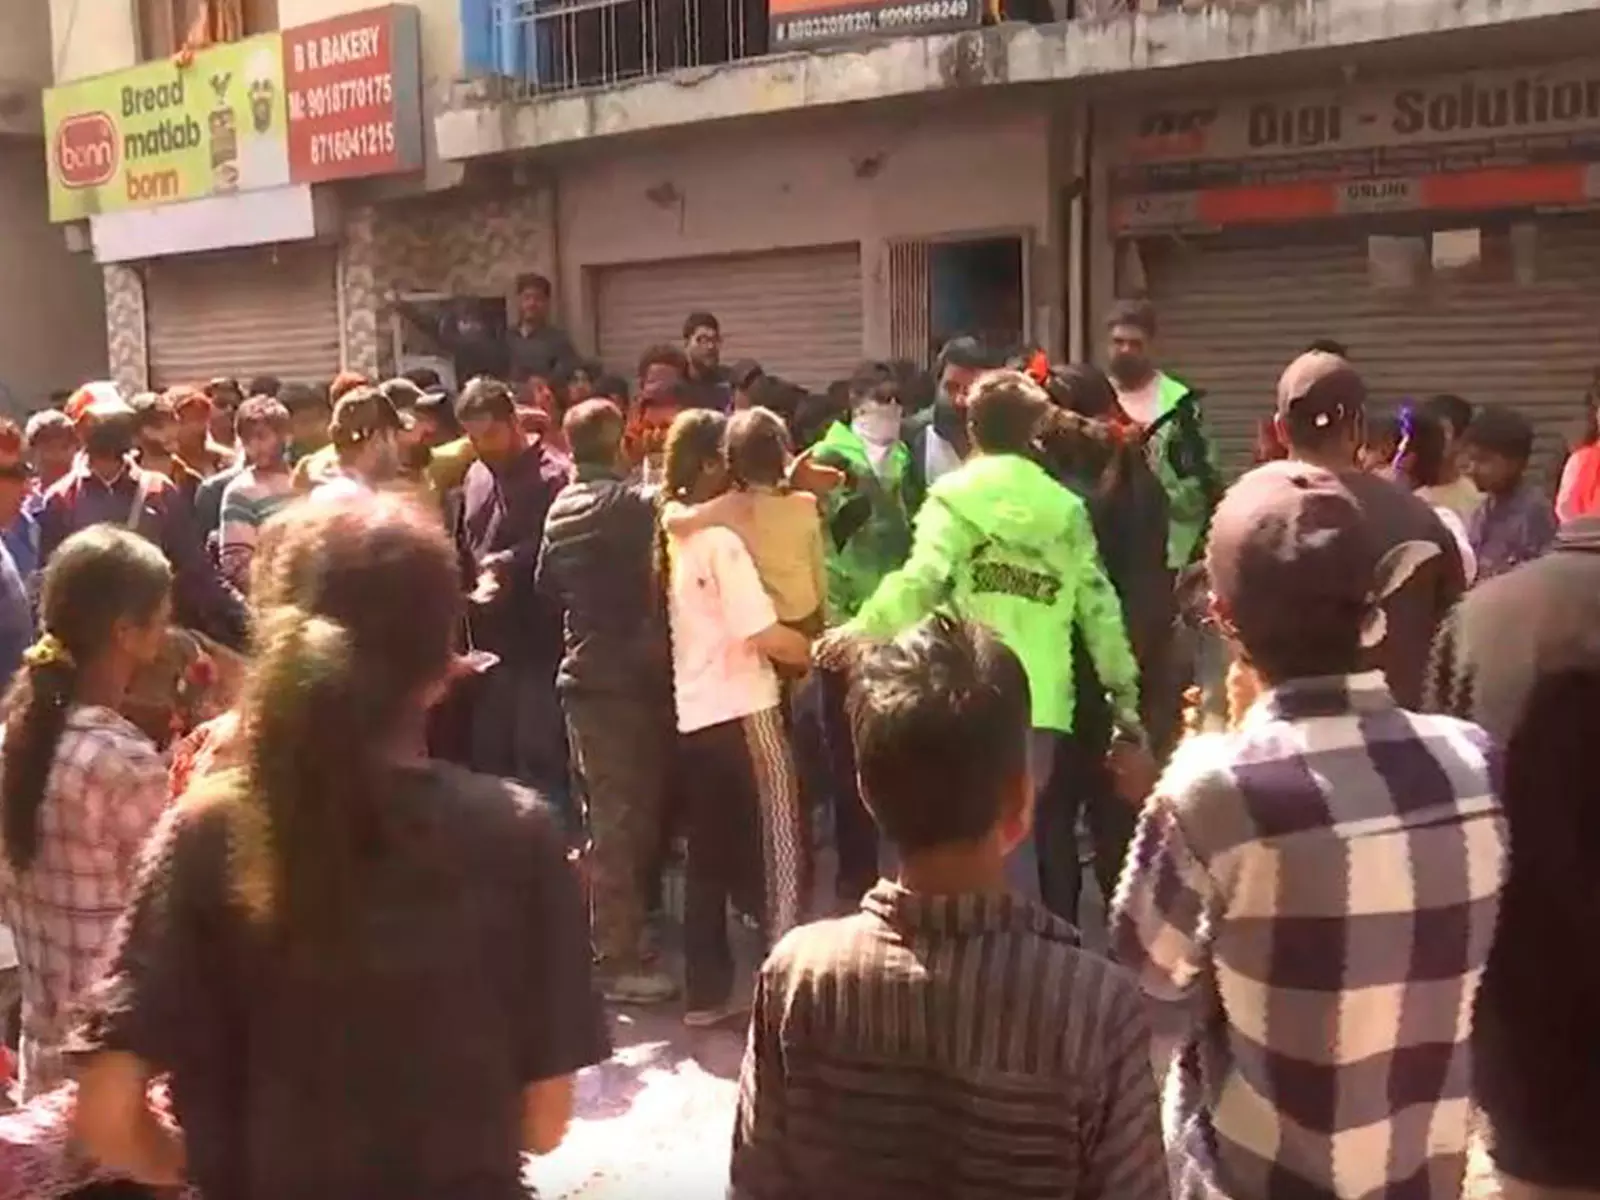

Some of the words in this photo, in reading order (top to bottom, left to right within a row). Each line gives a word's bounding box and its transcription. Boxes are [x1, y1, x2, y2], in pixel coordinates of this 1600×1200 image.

[294, 43, 305, 72] B
[307, 40, 318, 69] R
[320, 24, 380, 67] BAKERY
[121, 75, 184, 117] Bread
[124, 116, 200, 160] matlab
[1248, 102, 1341, 147] Digi
[62, 134, 111, 171] bonn
[126, 169, 179, 200] bonn
